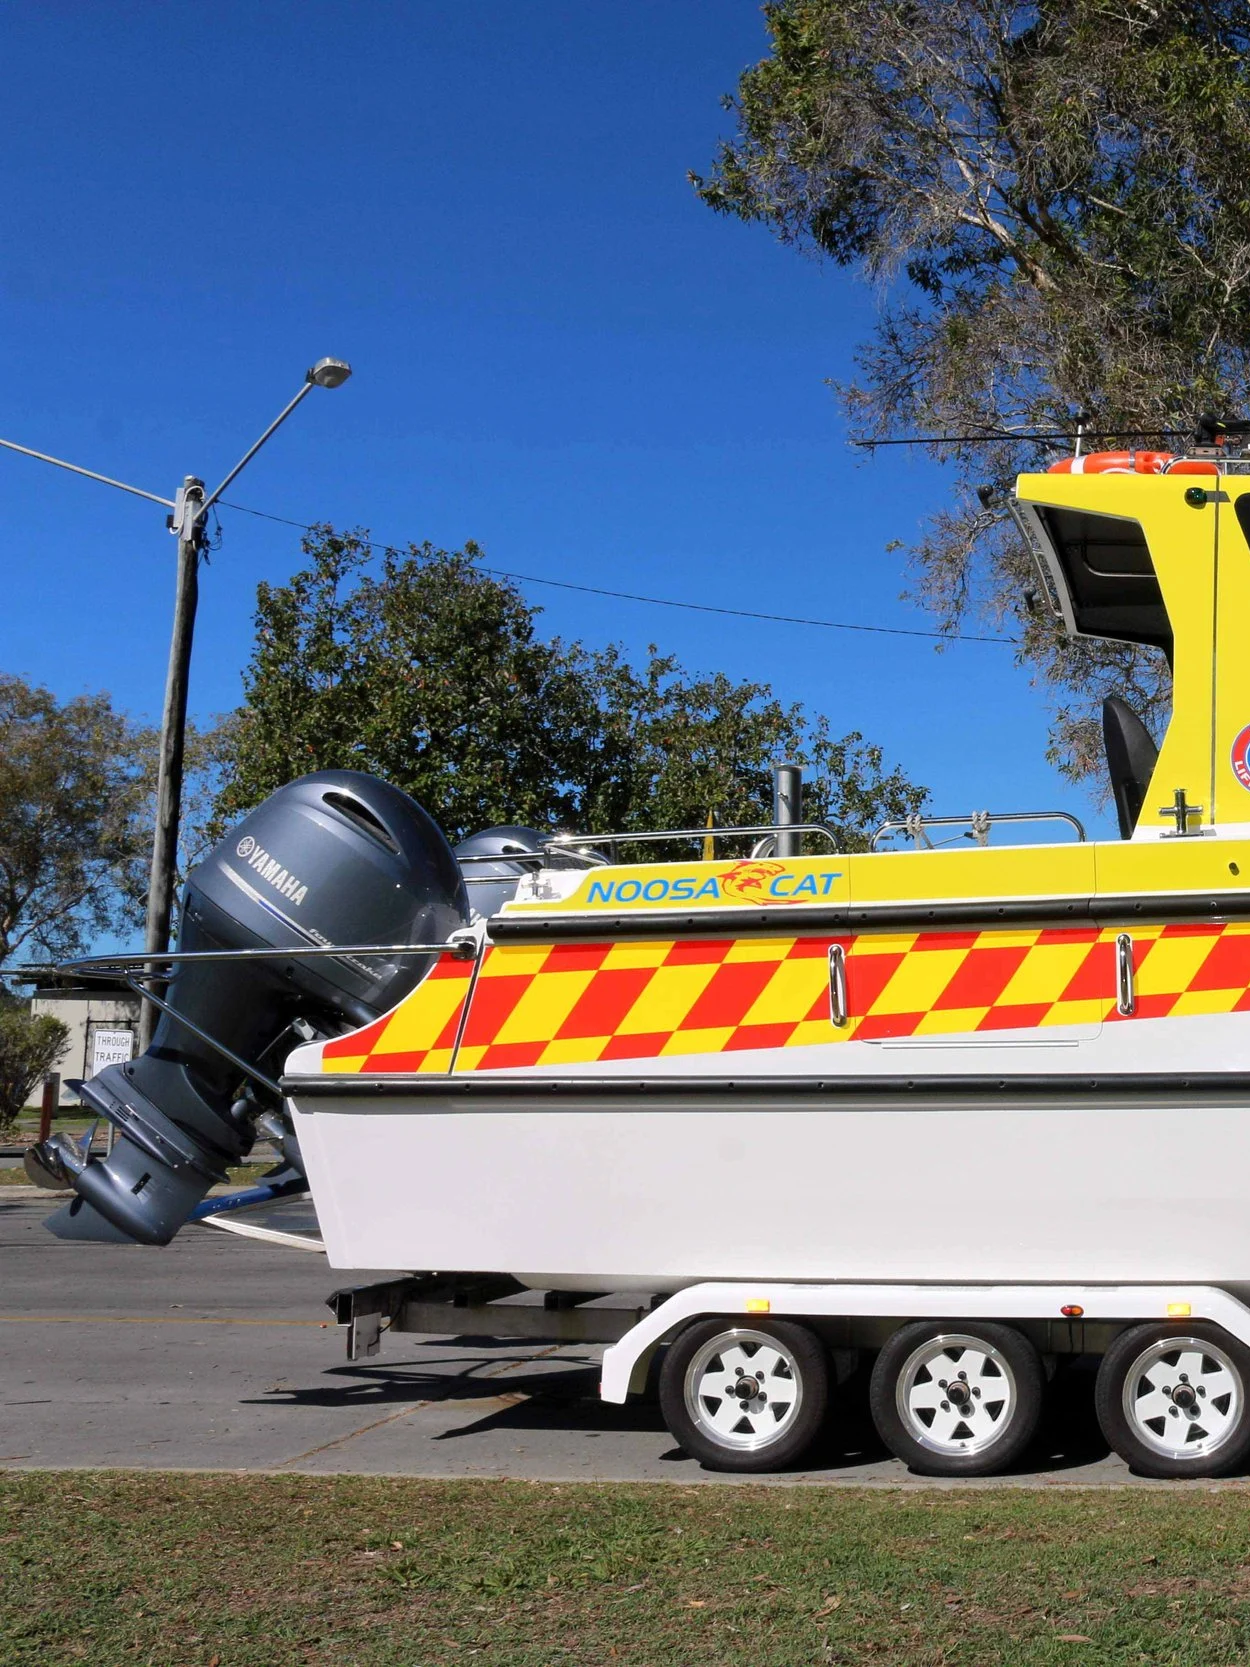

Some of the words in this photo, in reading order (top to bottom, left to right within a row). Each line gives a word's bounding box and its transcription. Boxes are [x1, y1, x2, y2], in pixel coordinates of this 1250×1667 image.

[247, 845, 309, 907] YAMAHA
[586, 877, 720, 903] NOOSA
[769, 873, 843, 897] CAT
[97, 1036, 130, 1047] THROUGH
[96, 1052, 130, 1063] TRAFFIC
